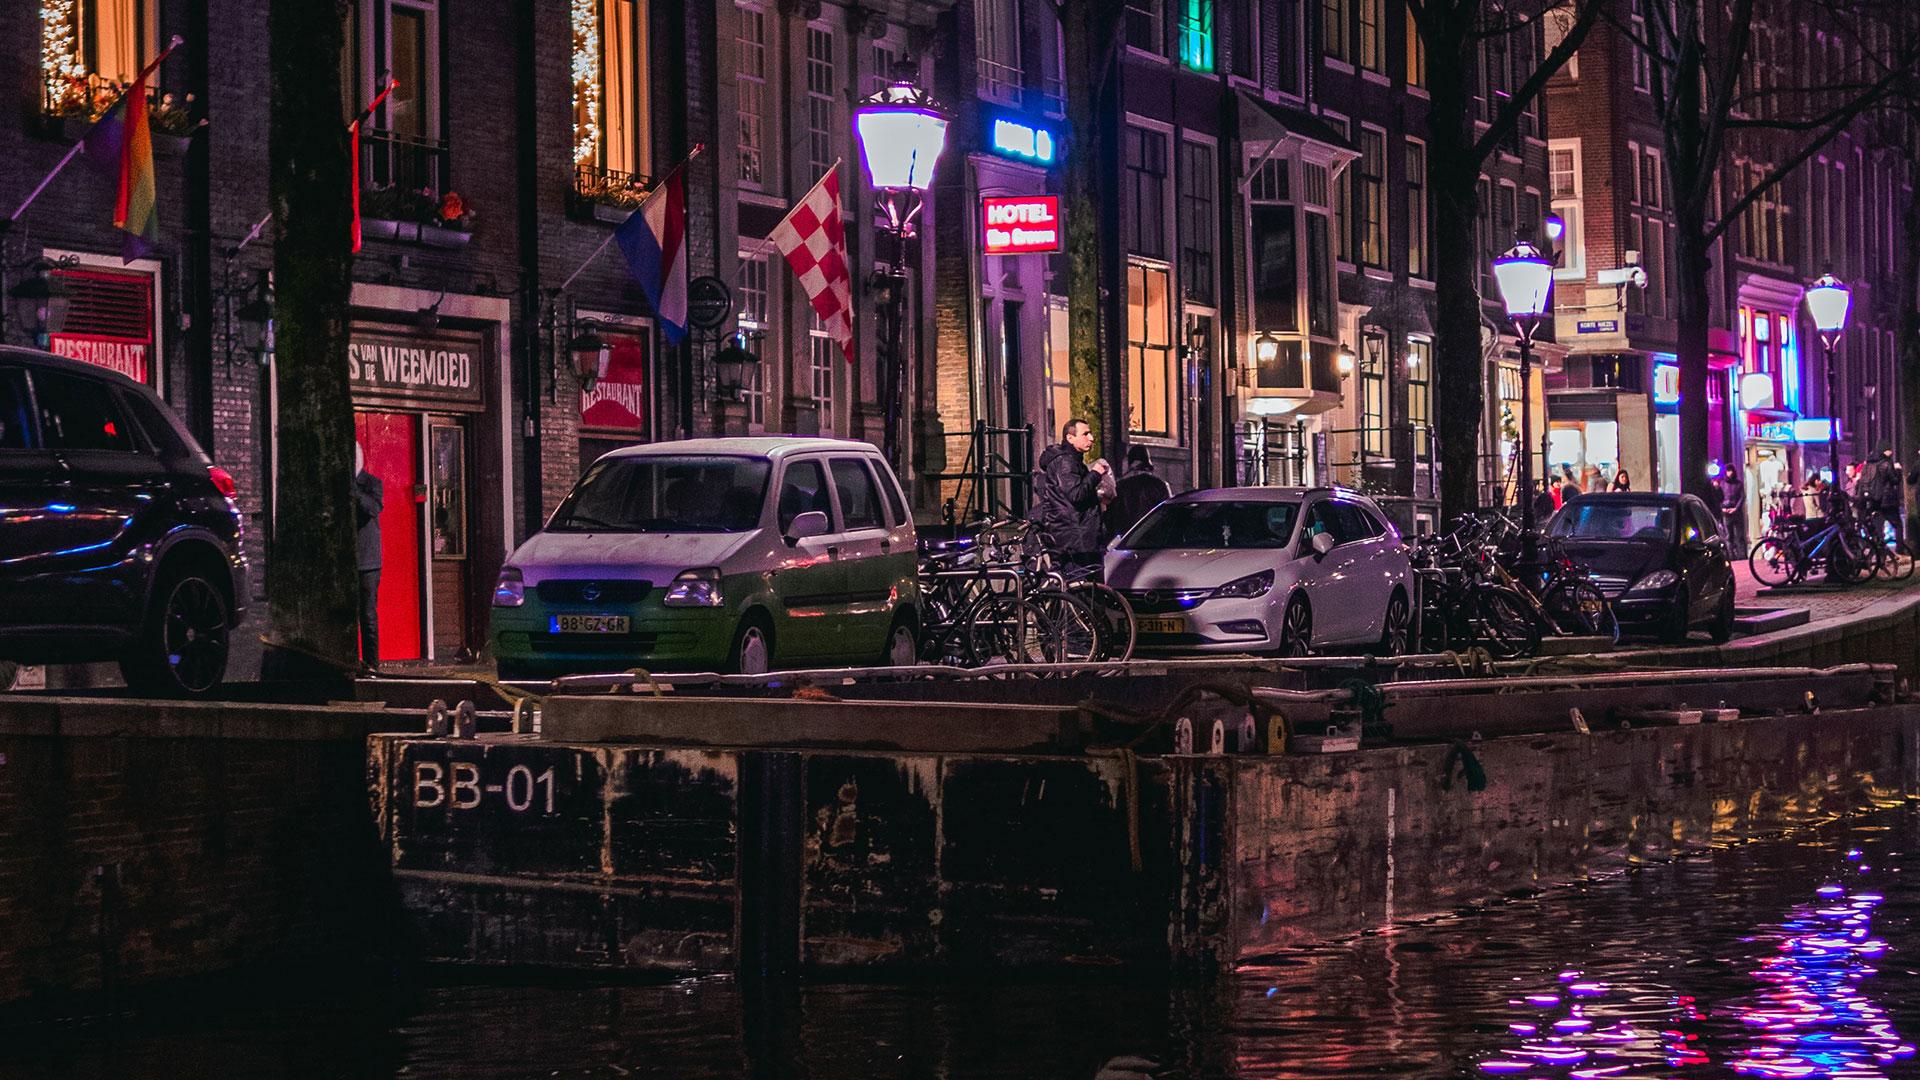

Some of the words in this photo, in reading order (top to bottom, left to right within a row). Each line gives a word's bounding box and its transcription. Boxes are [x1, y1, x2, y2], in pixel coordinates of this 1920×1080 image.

[988, 203, 1054, 225] HOTEL
[361, 344, 378, 362] VAN
[364, 363, 377, 381] DE
[380, 345, 470, 389] WEEMOED
[414, 761, 555, 813] BB-01
